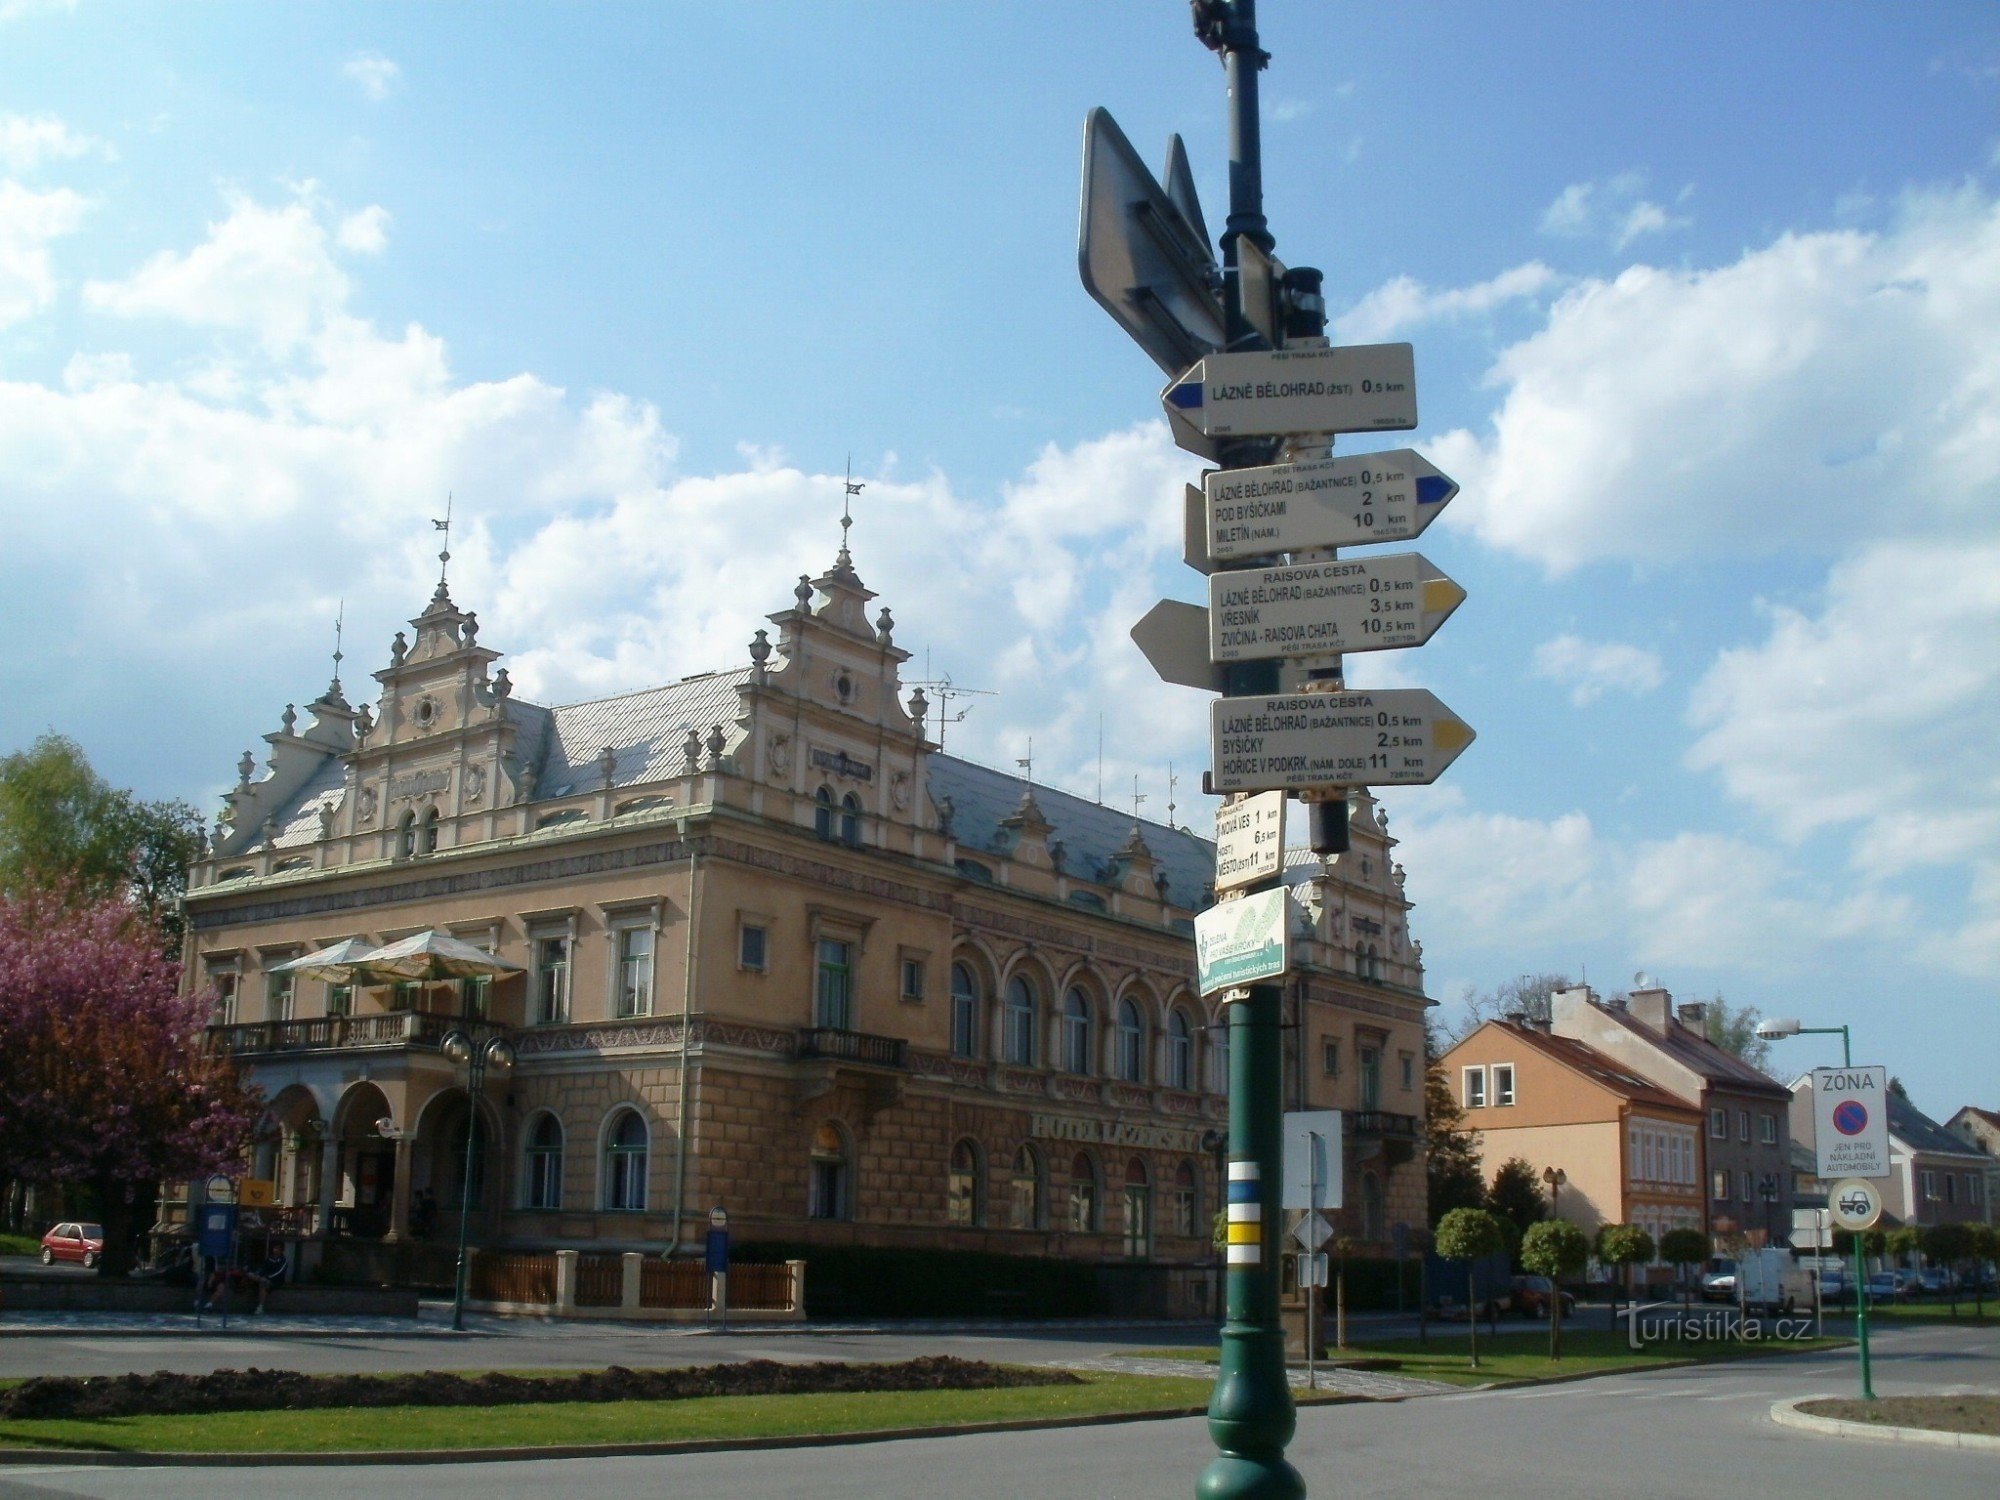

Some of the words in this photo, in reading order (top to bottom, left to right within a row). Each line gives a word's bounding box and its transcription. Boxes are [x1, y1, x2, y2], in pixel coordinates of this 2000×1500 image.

[1213, 383, 1253, 401] LÁZNĚ
[1256, 381, 1325, 399] BĚLOHRAD
[1386, 383, 1405, 392] km
[1214, 483, 1243, 502] LÁZNĚ
[1245, 480, 1293, 499] BĚLOHRAD
[1295, 475, 1357, 494] (BAŽANTNICE)
[1386, 472, 1405, 481] km
[1216, 507, 1235, 522] POD
[1237, 500, 1287, 520] BYŠIČKAMI
[1362, 491, 1373, 506] 2
[1387, 494, 1405, 503] km
[1216, 524, 1250, 543] MILETÍN
[1353, 512, 1374, 528] 10
[1388, 515, 1407, 524] km
[1264, 569, 1320, 584] RAISOVA
[1324, 565, 1367, 578] CESTA
[1221, 587, 1250, 607] LÁZNĚ
[1252, 586, 1302, 604] BĚLOHRAD
[1303, 584, 1366, 601] (BAŽANTNICE)
[1394, 581, 1413, 590] km
[1221, 607, 1260, 627] VŘESNÍK
[1395, 601, 1414, 610] km
[1221, 628, 1257, 647] ZVIČINA
[1264, 625, 1306, 643] RAISOVA
[1307, 622, 1339, 639] CHATA
[1396, 621, 1415, 631] km
[1302, 641, 1327, 650] TRASA
[1267, 699, 1326, 712] RAISOVA
[1329, 697, 1374, 709] CESTA
[1222, 714, 1253, 734] LÁZNĚ
[1255, 713, 1308, 732] BĚLOHRAD
[1309, 715, 1374, 732] (BAŽANTNICE)
[1402, 716, 1422, 726] km
[1223, 735, 1264, 755] BYŠIČKY
[1403, 736, 1422, 747] km
[1223, 756, 1258, 775] HOŘICE
[1260, 758, 1266, 773] V
[1268, 755, 1309, 773] PODKRK.
[1338, 757, 1367, 770] DOLE)
[1369, 753, 1388, 769] 11
[1404, 756, 1423, 767] km
[1307, 772, 1334, 781] TRASA
[1221, 815, 1237, 836] NOVÁ
[1238, 813, 1250, 829] VES
[1255, 810, 1260, 824] 1
[1267, 810, 1277, 819] km
[1267, 831, 1276, 840] km
[1250, 851, 1259, 867] 11
[1265, 851, 1275, 861] km
[1268, 960, 1281, 970] tras
[1822, 1070, 1875, 1092] ZÓNA
[1834, 1143, 1851, 1152] JEN
[1854, 1141, 1872, 1150] PRO
